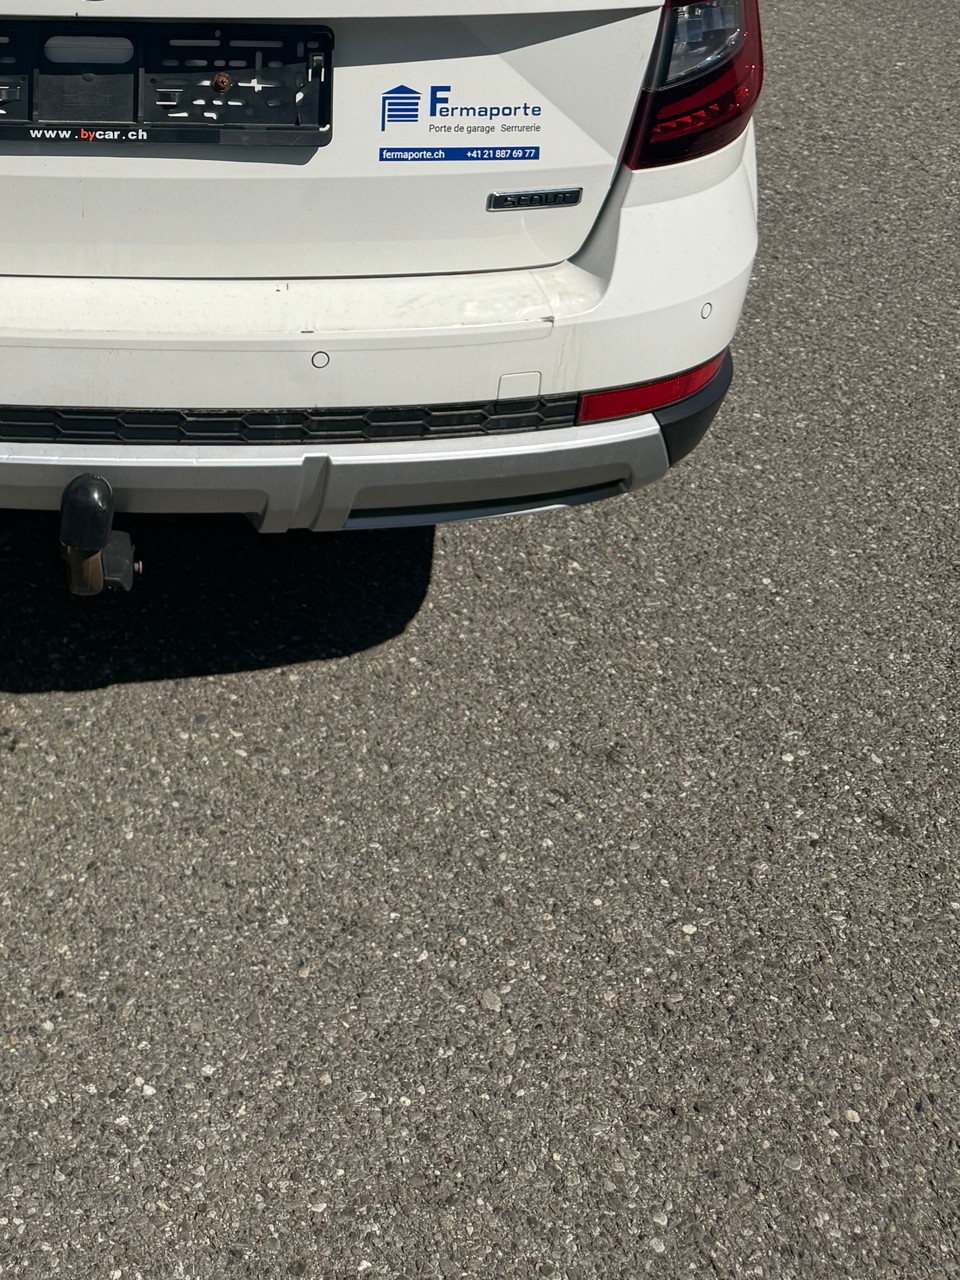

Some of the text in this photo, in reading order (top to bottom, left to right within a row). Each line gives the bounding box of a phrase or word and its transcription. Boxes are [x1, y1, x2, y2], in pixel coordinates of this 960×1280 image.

[429, 85, 542, 120] Fermaporte
[428, 123, 541, 134] Porte de garage Serrurerie
[382, 149, 536, 161] fermaporte.ch +41 21 887 69 77
